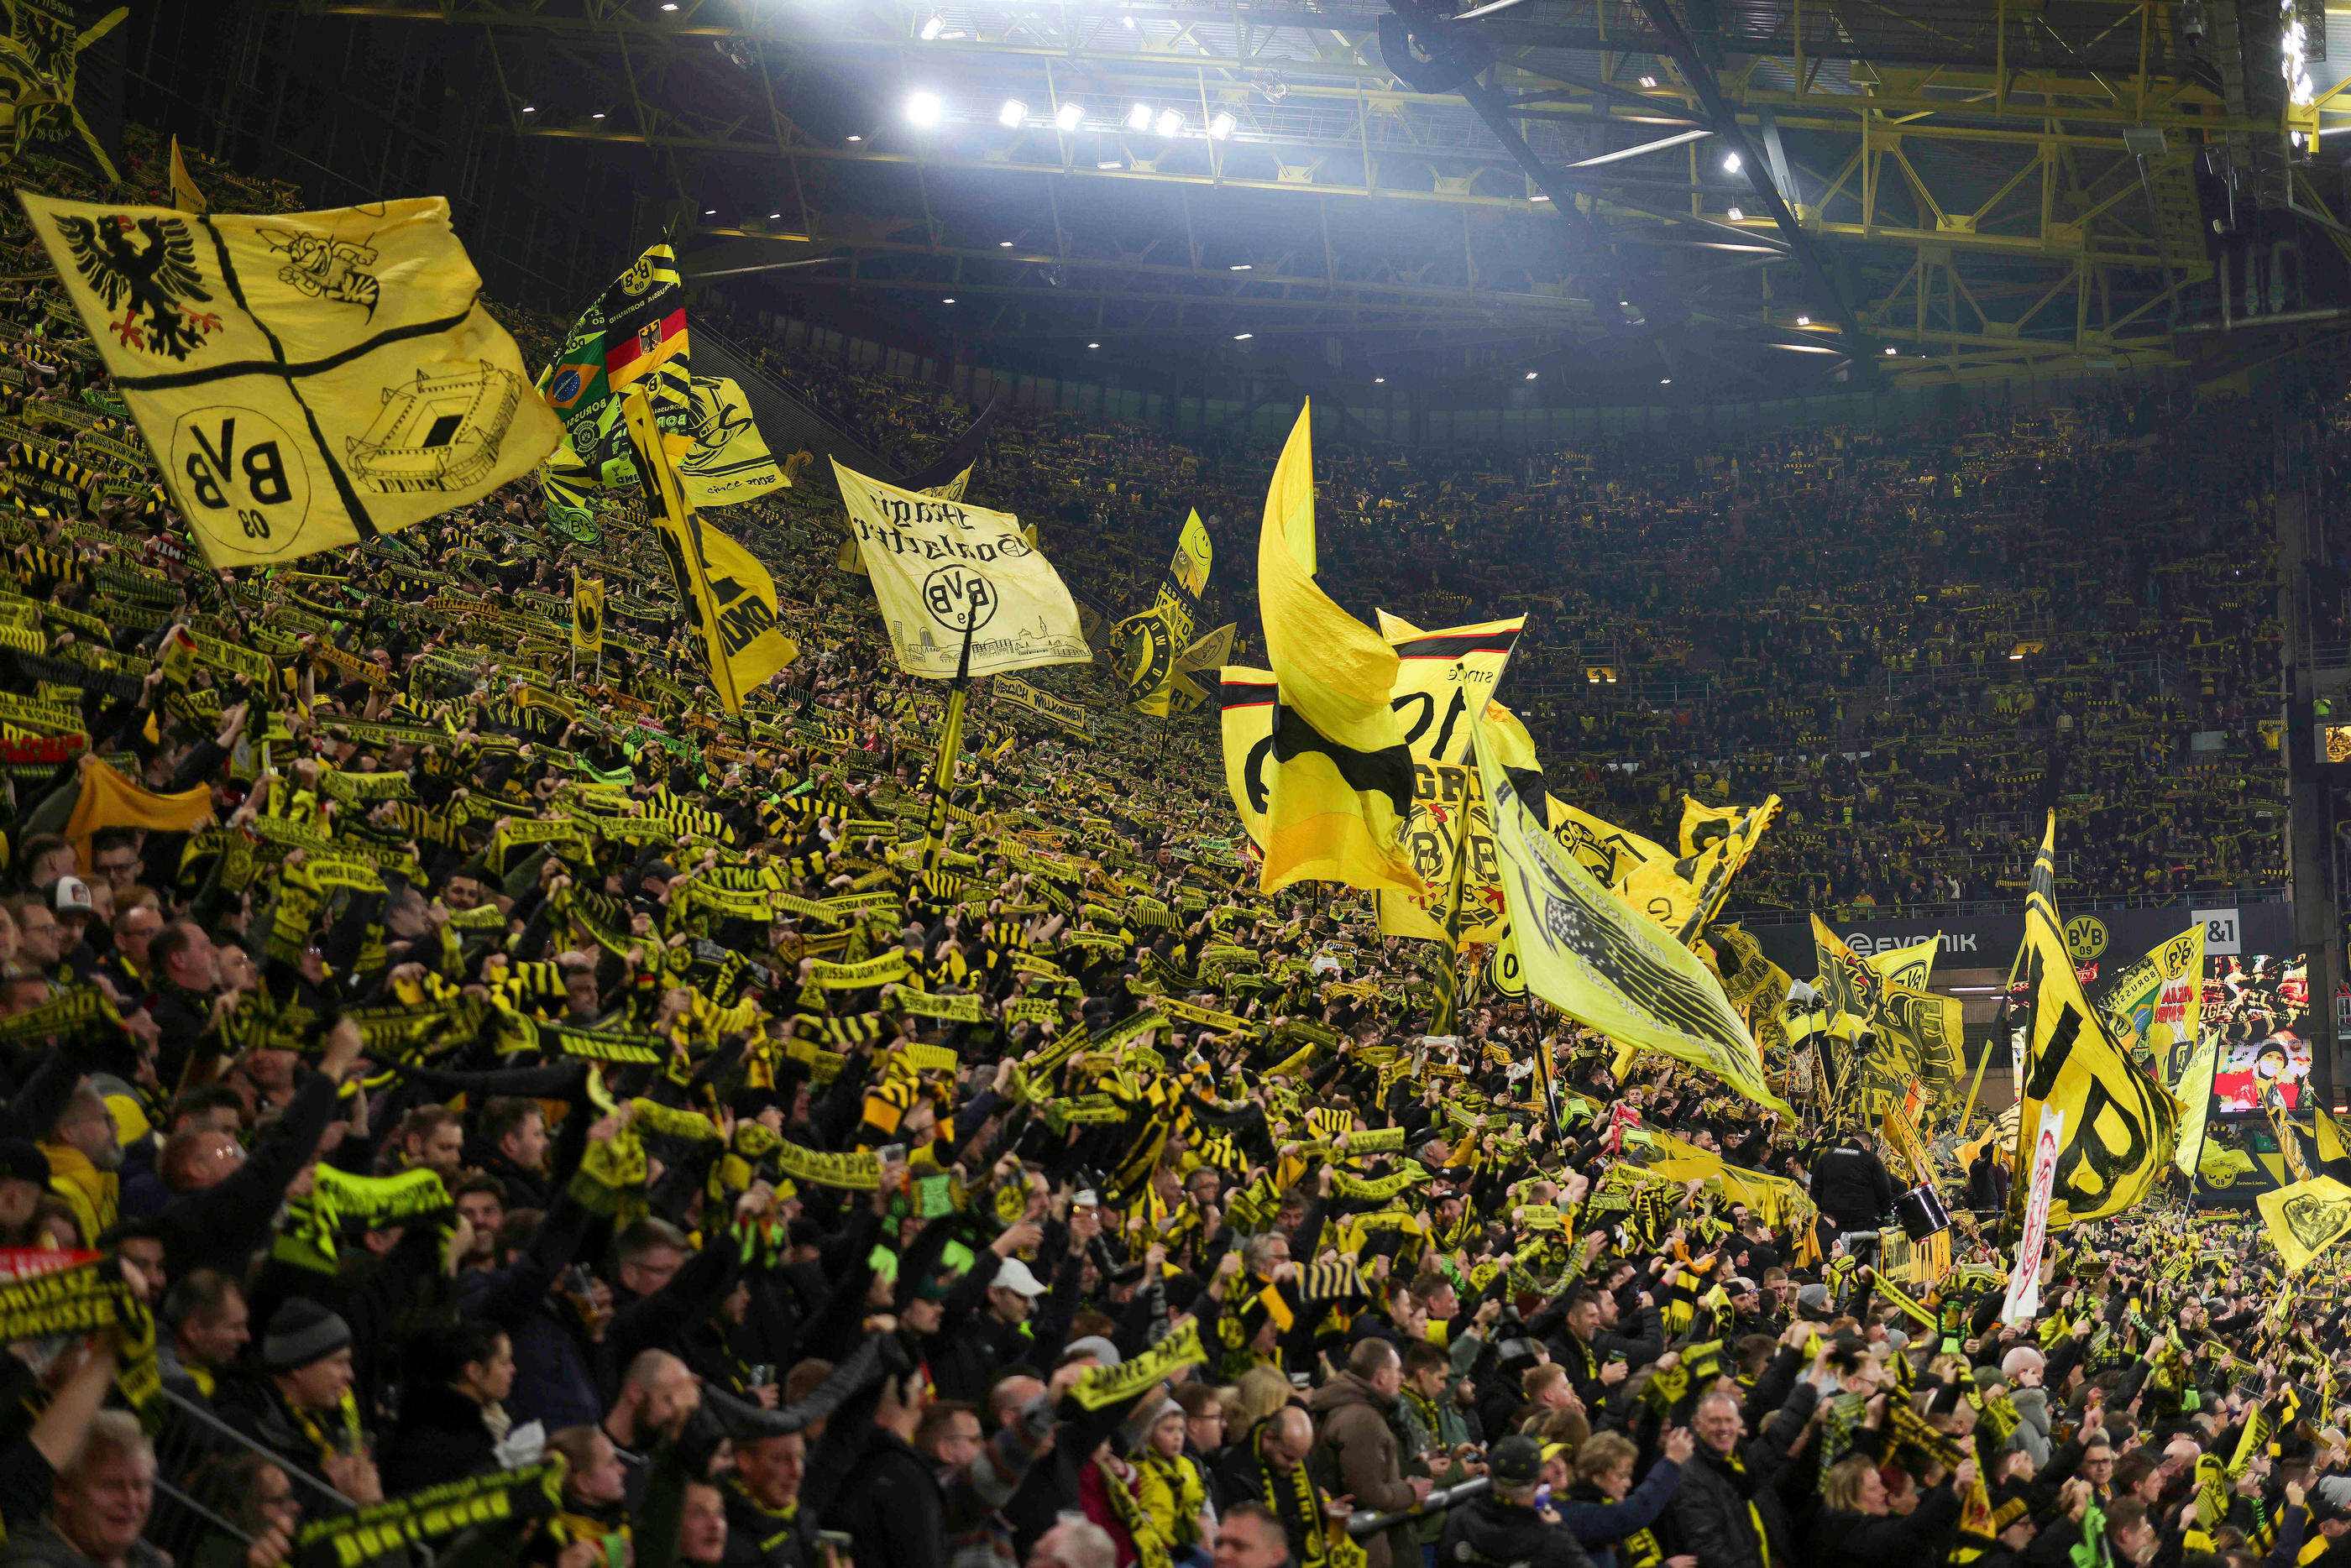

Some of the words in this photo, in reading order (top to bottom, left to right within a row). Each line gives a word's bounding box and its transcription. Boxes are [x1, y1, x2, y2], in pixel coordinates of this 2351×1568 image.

[1875, 933, 1978, 953] EVONIK
[2068, 919, 2105, 947] BVB
[2079, 945, 2093, 955] 09
